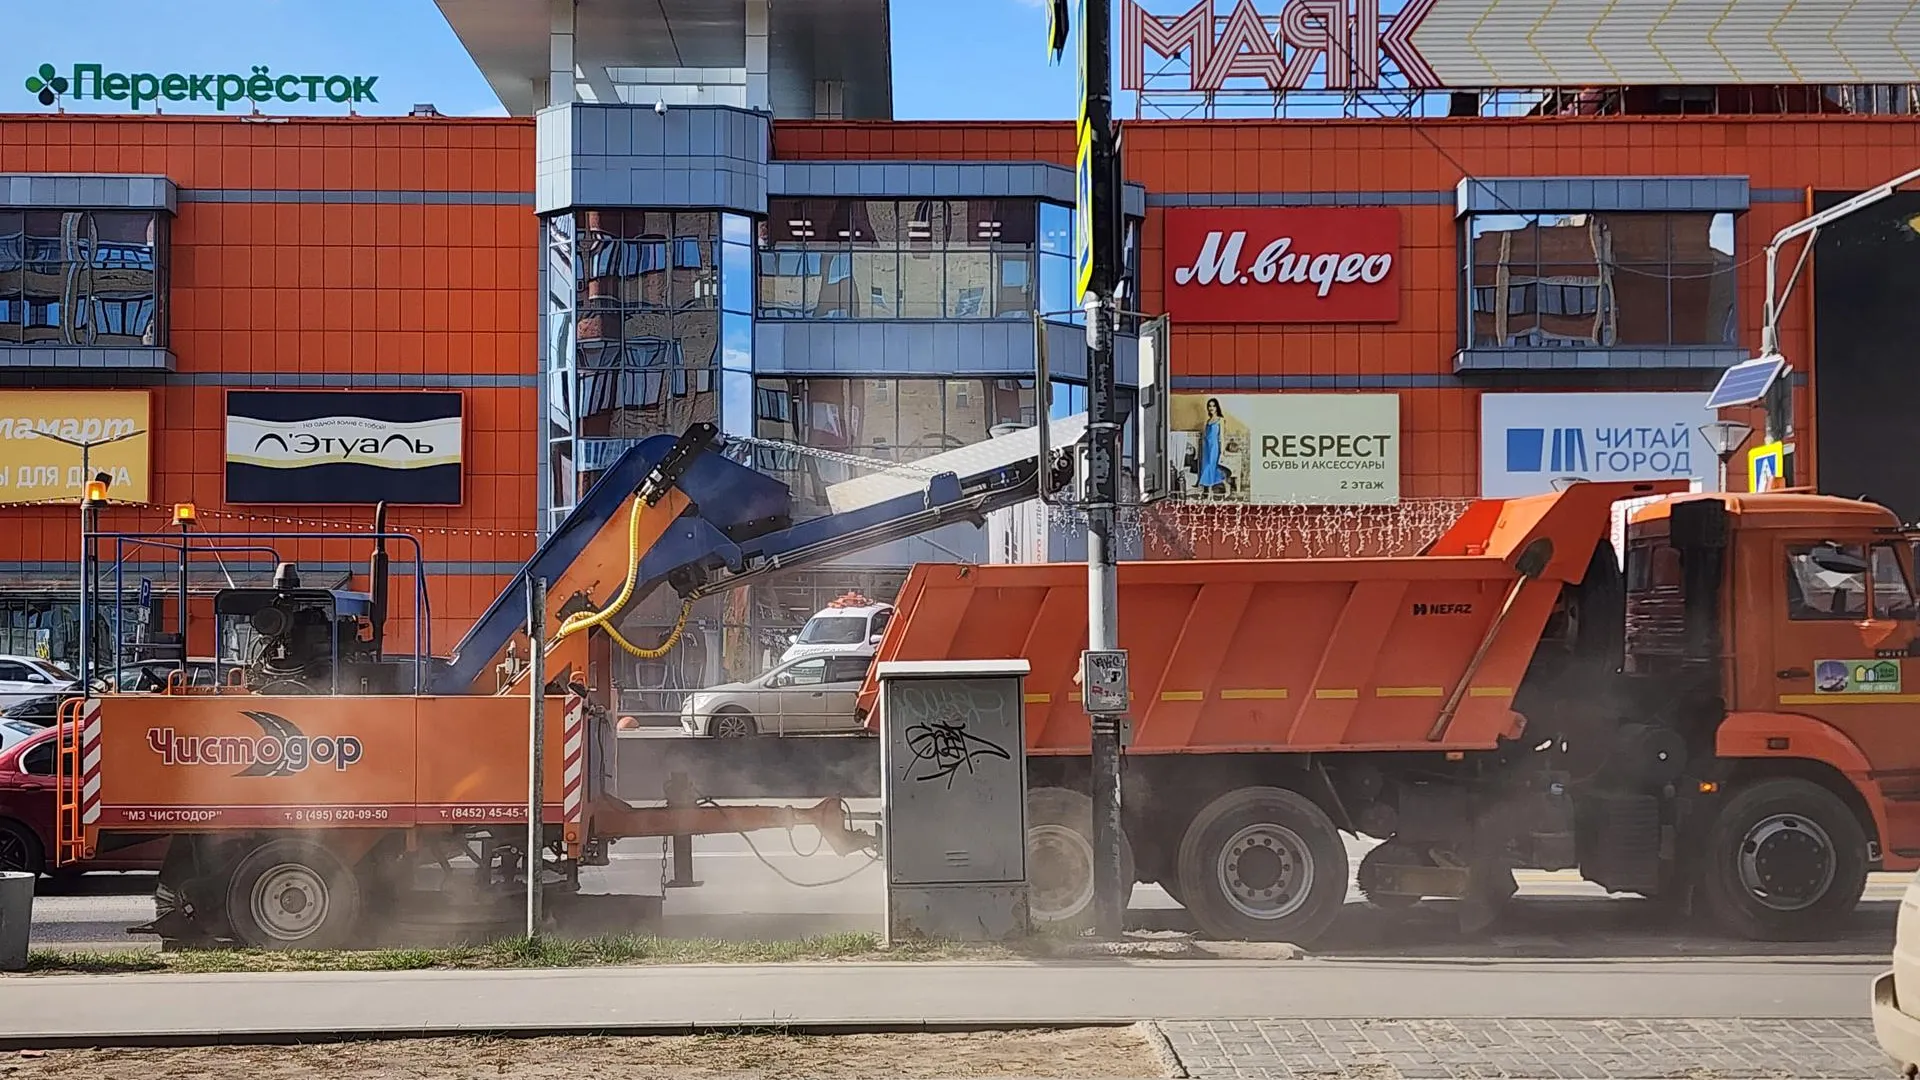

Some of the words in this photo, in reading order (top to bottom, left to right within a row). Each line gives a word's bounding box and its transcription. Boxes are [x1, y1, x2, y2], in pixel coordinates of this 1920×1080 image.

[1121, 0, 1444, 90] МАЯК
[73, 63, 380, 111] Перекрёсток
[1175, 231, 1392, 297] М.видео
[1262, 435, 1391, 458] RESPECT
[1596, 422, 1690, 449] ЧИТАЙ
[1262, 460, 1299, 470] ОБУВЬ
[1301, 460, 1309, 470] И
[1311, 460, 1385, 470] АКСЕССУАРЫ
[1596, 451, 1692, 476] ГОРОД
[17, 466, 59, 489] ДЛЯ
[1340, 480, 1348, 490] 2
[1351, 480, 1384, 490] этаж
[1430, 603, 1473, 615] NEFAZ
[146, 727, 363, 772] Чистодор
[296, 810, 303, 820] 8
[305, 810, 333, 821] (495)
[335, 809, 388, 820] 620-09-50
[451, 807, 486, 819] (8452)
[488, 807, 529, 818] 45-45-1
